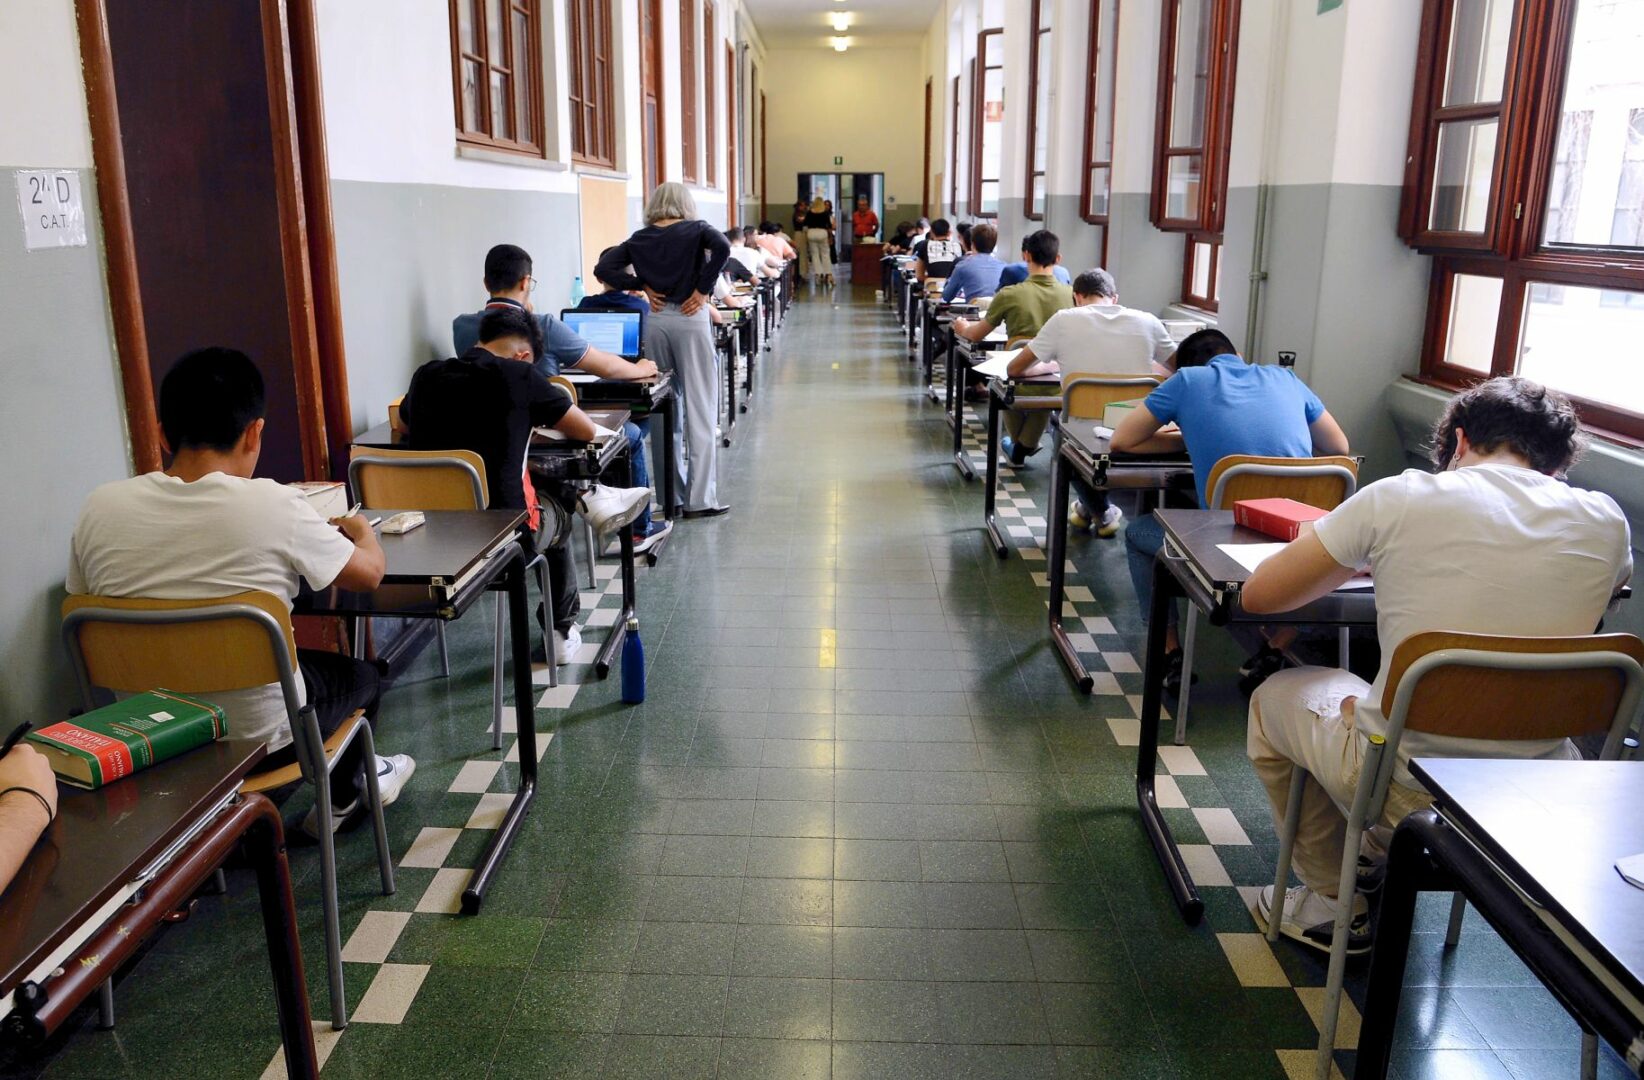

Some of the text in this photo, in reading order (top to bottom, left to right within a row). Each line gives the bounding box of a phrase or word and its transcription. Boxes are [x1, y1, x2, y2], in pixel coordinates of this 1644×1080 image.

[56, 177, 70, 203] D
[40, 214, 70, 229] C.A.T.
[66, 729, 112, 746] ITALIANO
